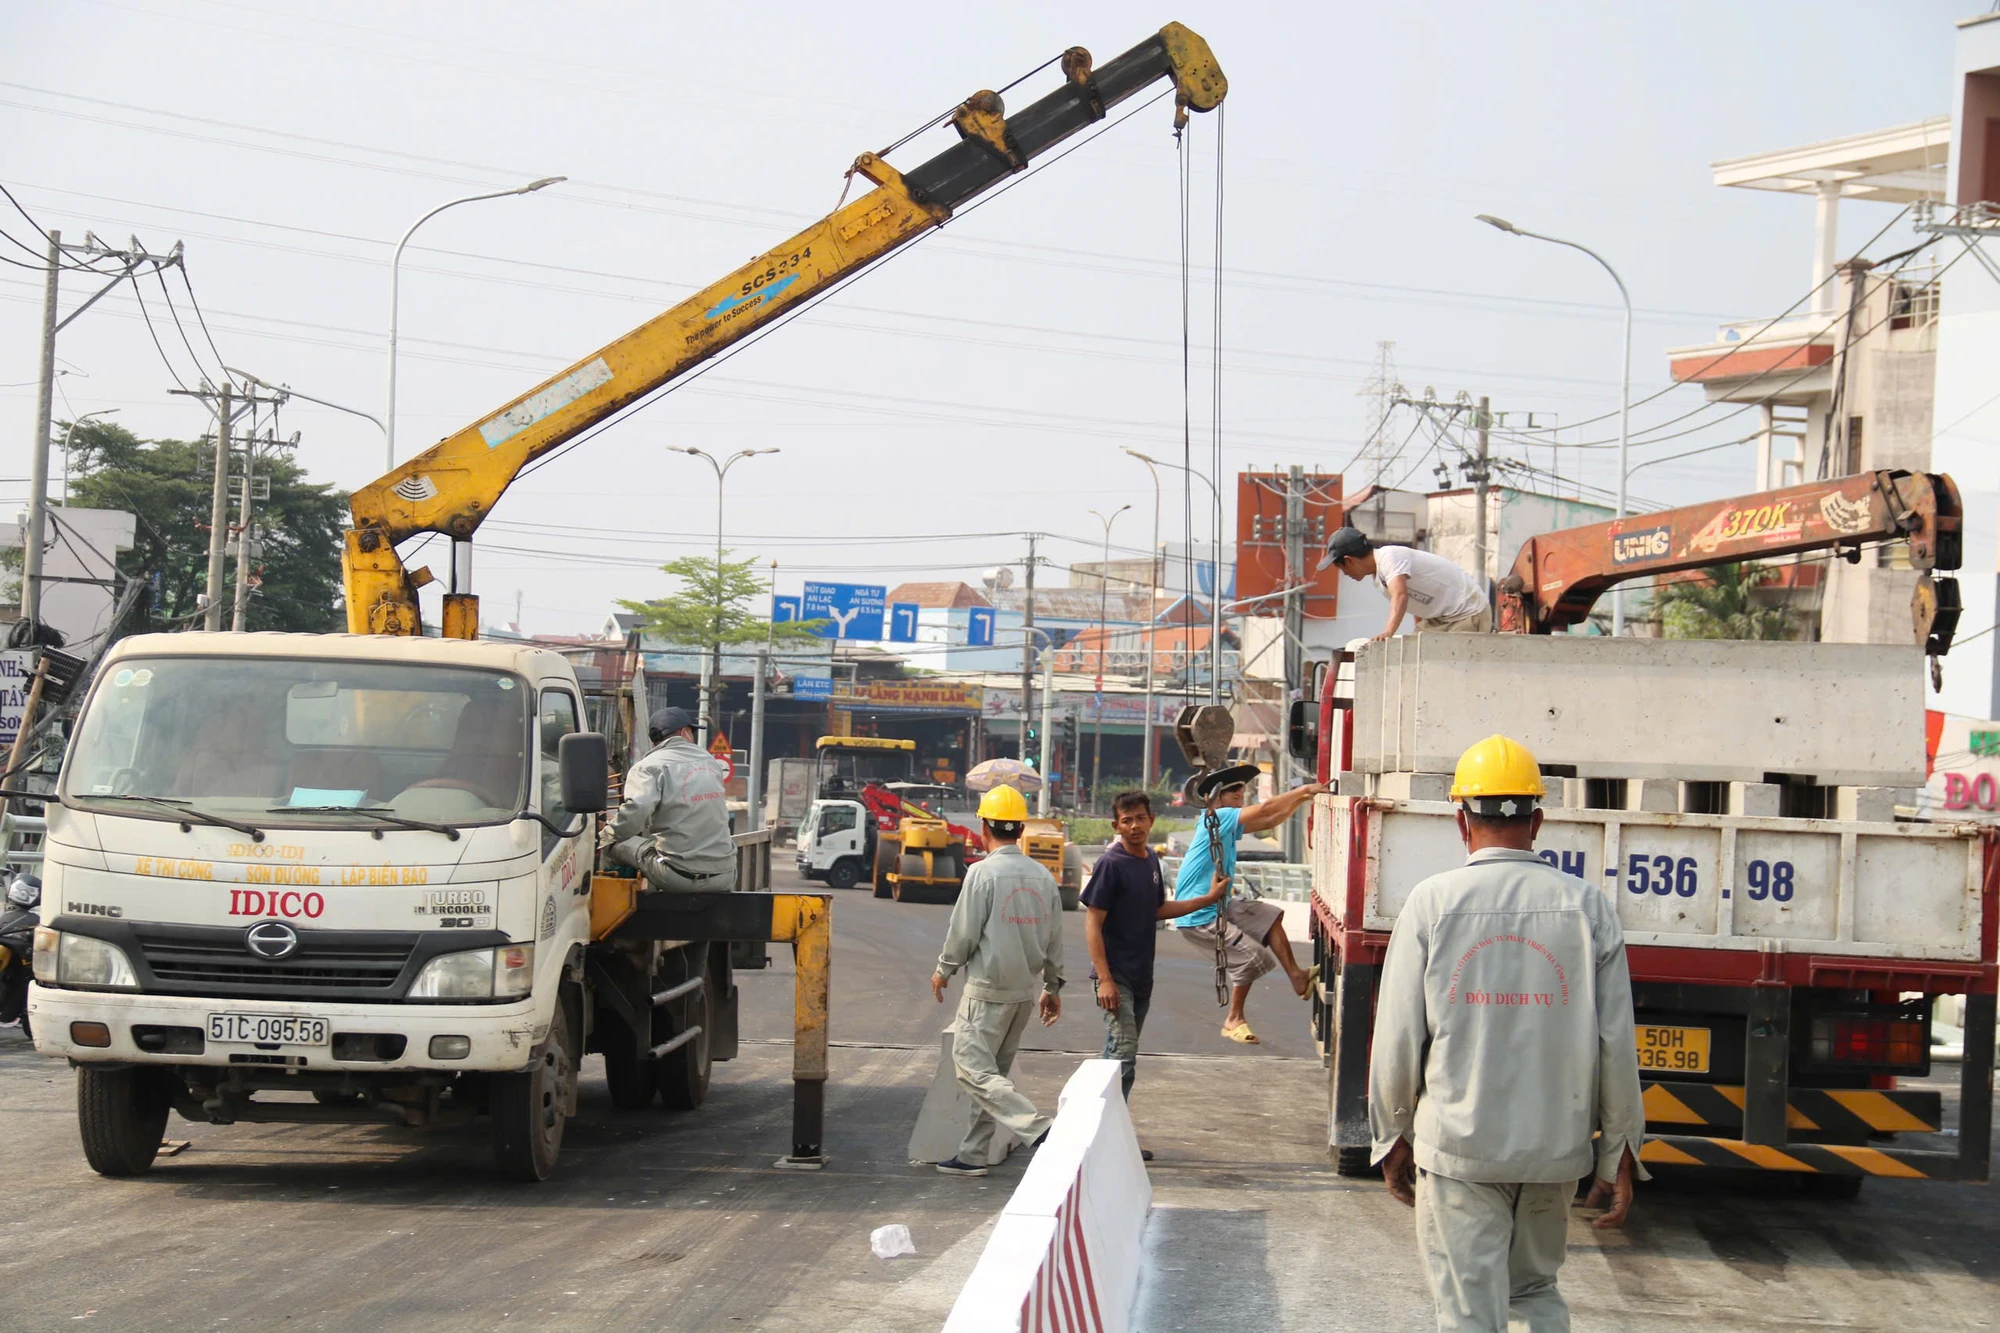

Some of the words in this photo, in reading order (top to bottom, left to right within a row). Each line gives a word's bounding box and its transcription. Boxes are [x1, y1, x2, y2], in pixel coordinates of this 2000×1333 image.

[684, 332, 700, 345] The
[699, 318, 722, 341] power
[723, 312, 731, 323] to
[731, 296, 762, 318] Success
[1724, 502, 1791, 538] 370K
[807, 594, 818, 602] AN
[849, 597, 861, 605] AN
[1, 685, 27, 706] TÂY
[815, 680, 830, 689] ETC
[1943, 772, 2000, 812] ĐO
[135, 856, 152, 875] XE
[155, 858, 175, 877] THI
[178, 857, 213, 880] CÔNG
[1748, 859, 1795, 901] 98
[68, 901, 123, 918] HINO
[229, 889, 325, 919] IDICO
[423, 890, 485, 916] TURBO
[1465, 988, 1491, 1007] ĐỘI
[1495, 992, 1530, 1008] DỊCH
[1533, 993, 1555, 1009] VỤ
[211, 1016, 324, 1043] 51C-095.58
[1645, 1028, 1684, 1048] 50H
